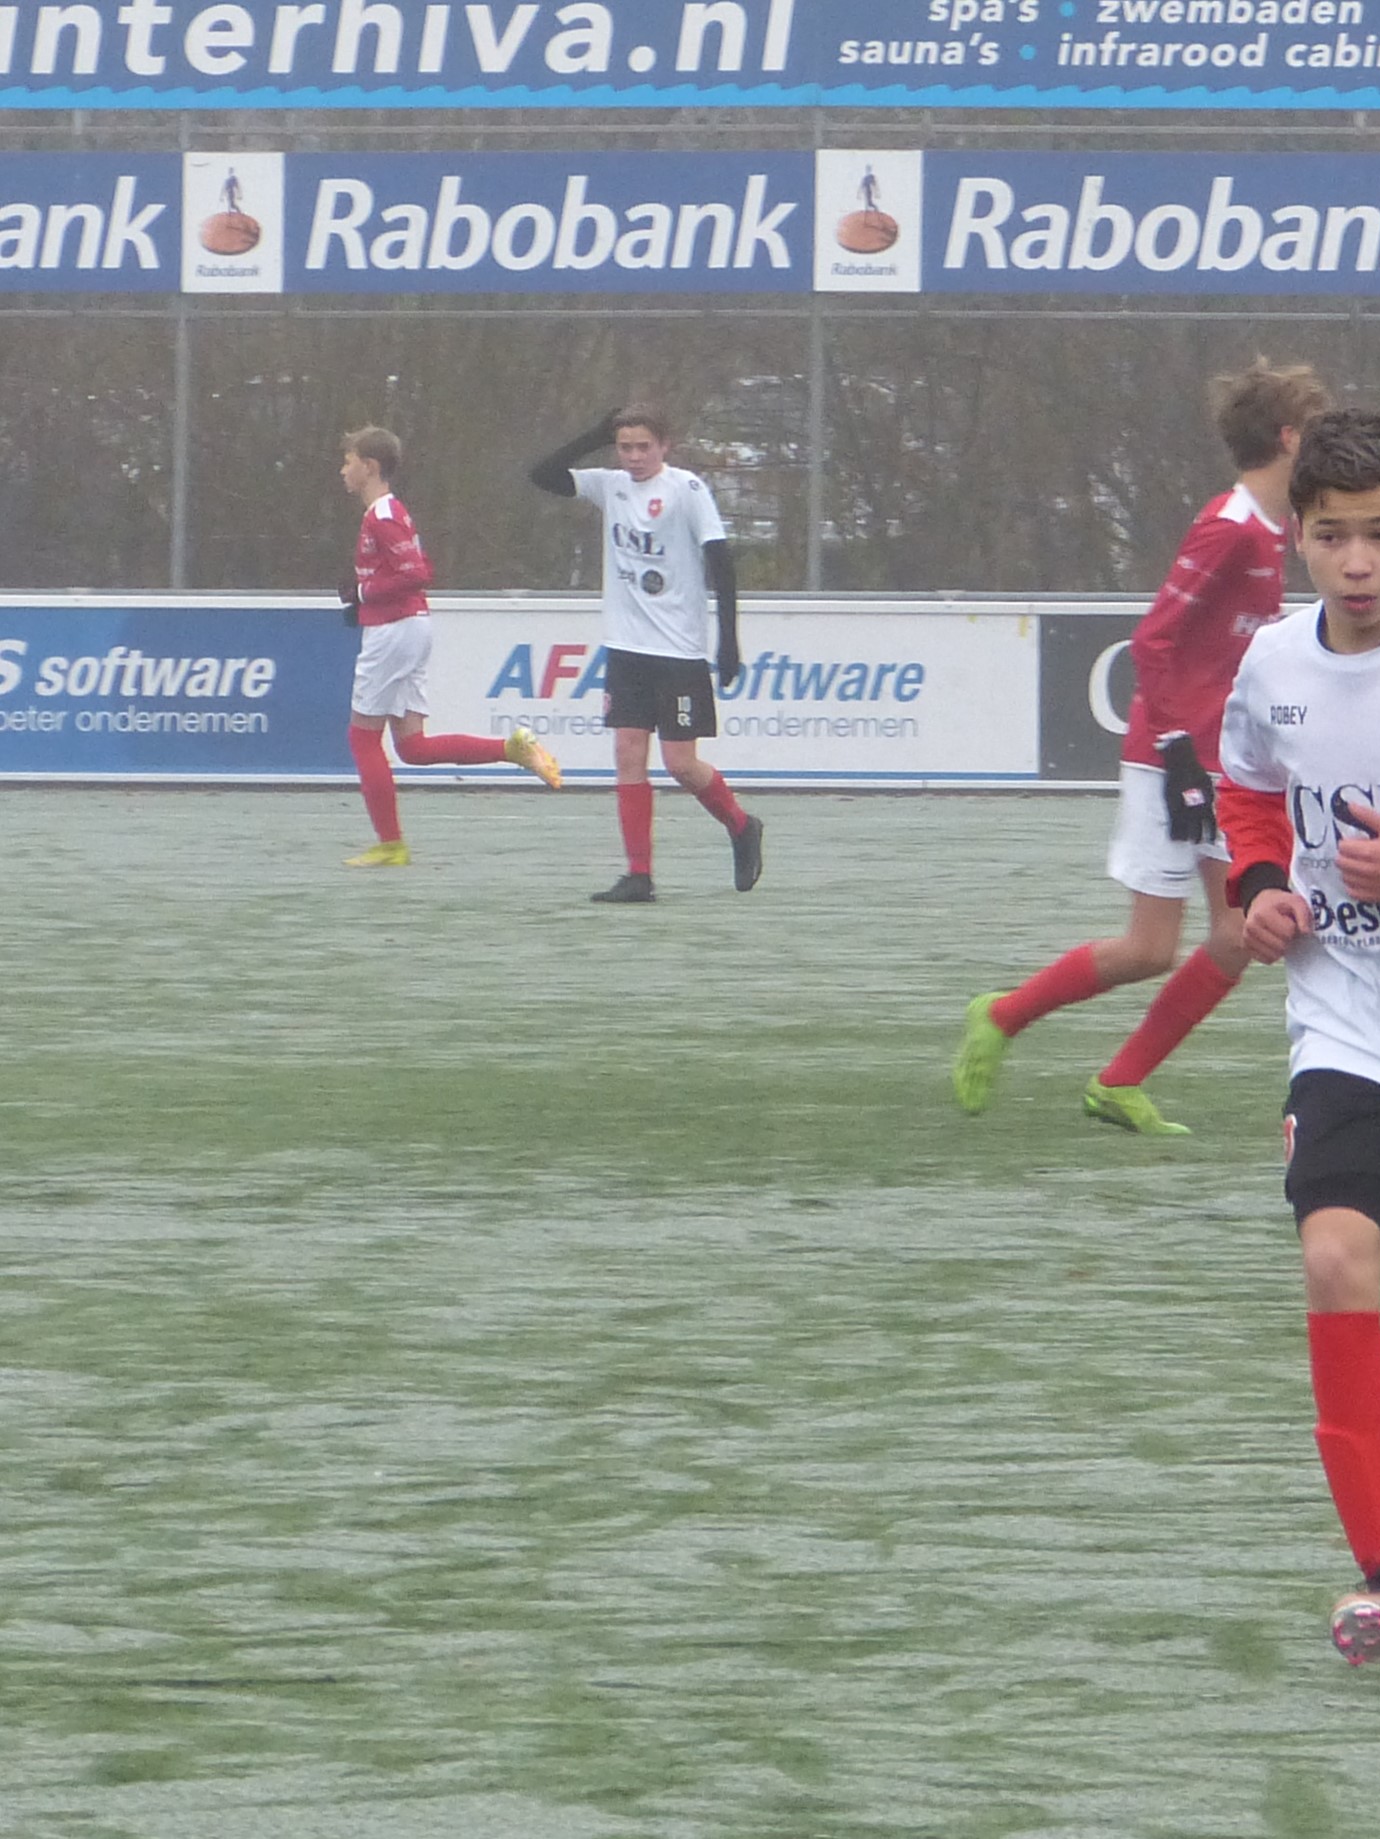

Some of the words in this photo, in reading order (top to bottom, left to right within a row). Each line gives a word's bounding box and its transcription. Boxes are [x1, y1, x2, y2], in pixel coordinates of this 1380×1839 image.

[929, 0, 1039, 31] spa's
[1097, 0, 1363, 25] zwembaden
[839, 33, 999, 66] sauna's
[1058, 33, 1268, 67] infrarood
[306, 175, 797, 271] Rabobank
[35, 647, 276, 698] software
[484, 643, 608, 699] AFA
[709, 651, 924, 702] oftware
[75, 705, 269, 733] ondernemen
[724, 711, 919, 737] ondernemen
[1270, 705, 1307, 725] ROBEY
